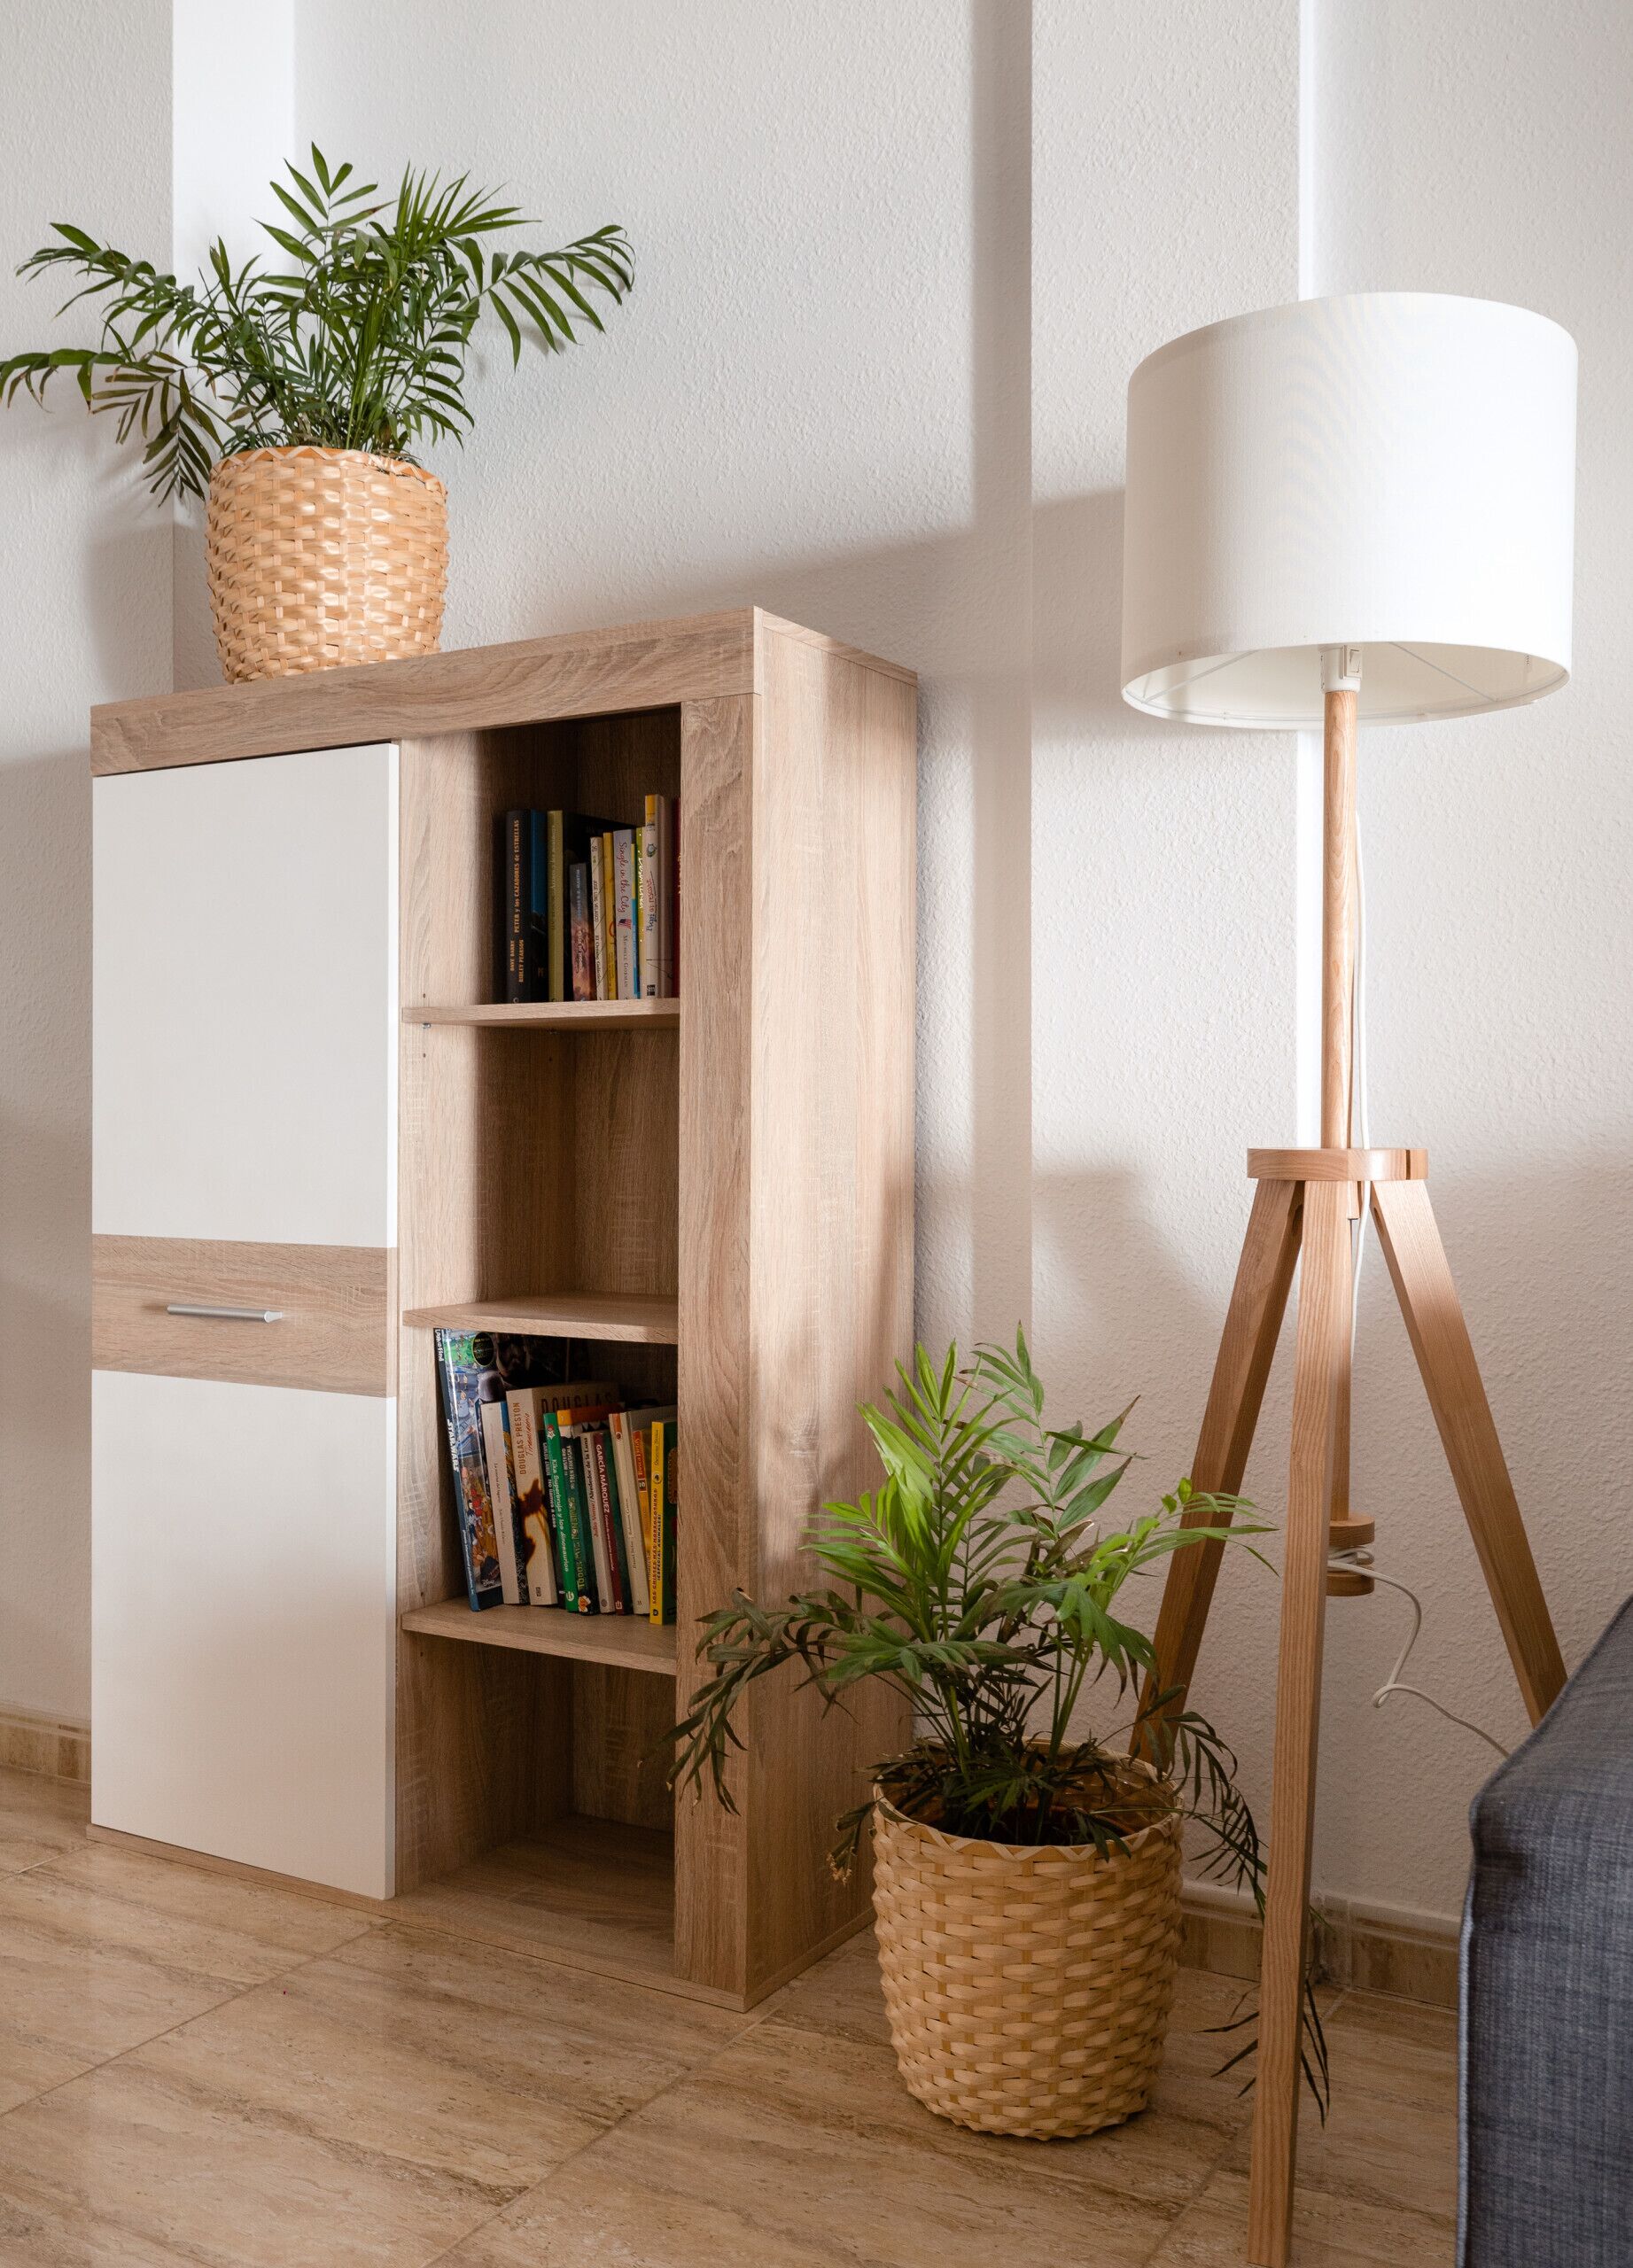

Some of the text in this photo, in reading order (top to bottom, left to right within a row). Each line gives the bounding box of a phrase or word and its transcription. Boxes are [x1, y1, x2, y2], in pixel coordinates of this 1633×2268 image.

[617, 843, 628, 868] Single
[618, 896, 630, 913] City
[513, 1402, 526, 1474] DOUGLAS PRESTON
[595, 1444, 610, 1513] GARCÍA MÁRQUEZ
[553, 1475, 564, 1511] Superbruja
[560, 1532, 570, 1572] dinosaurios
